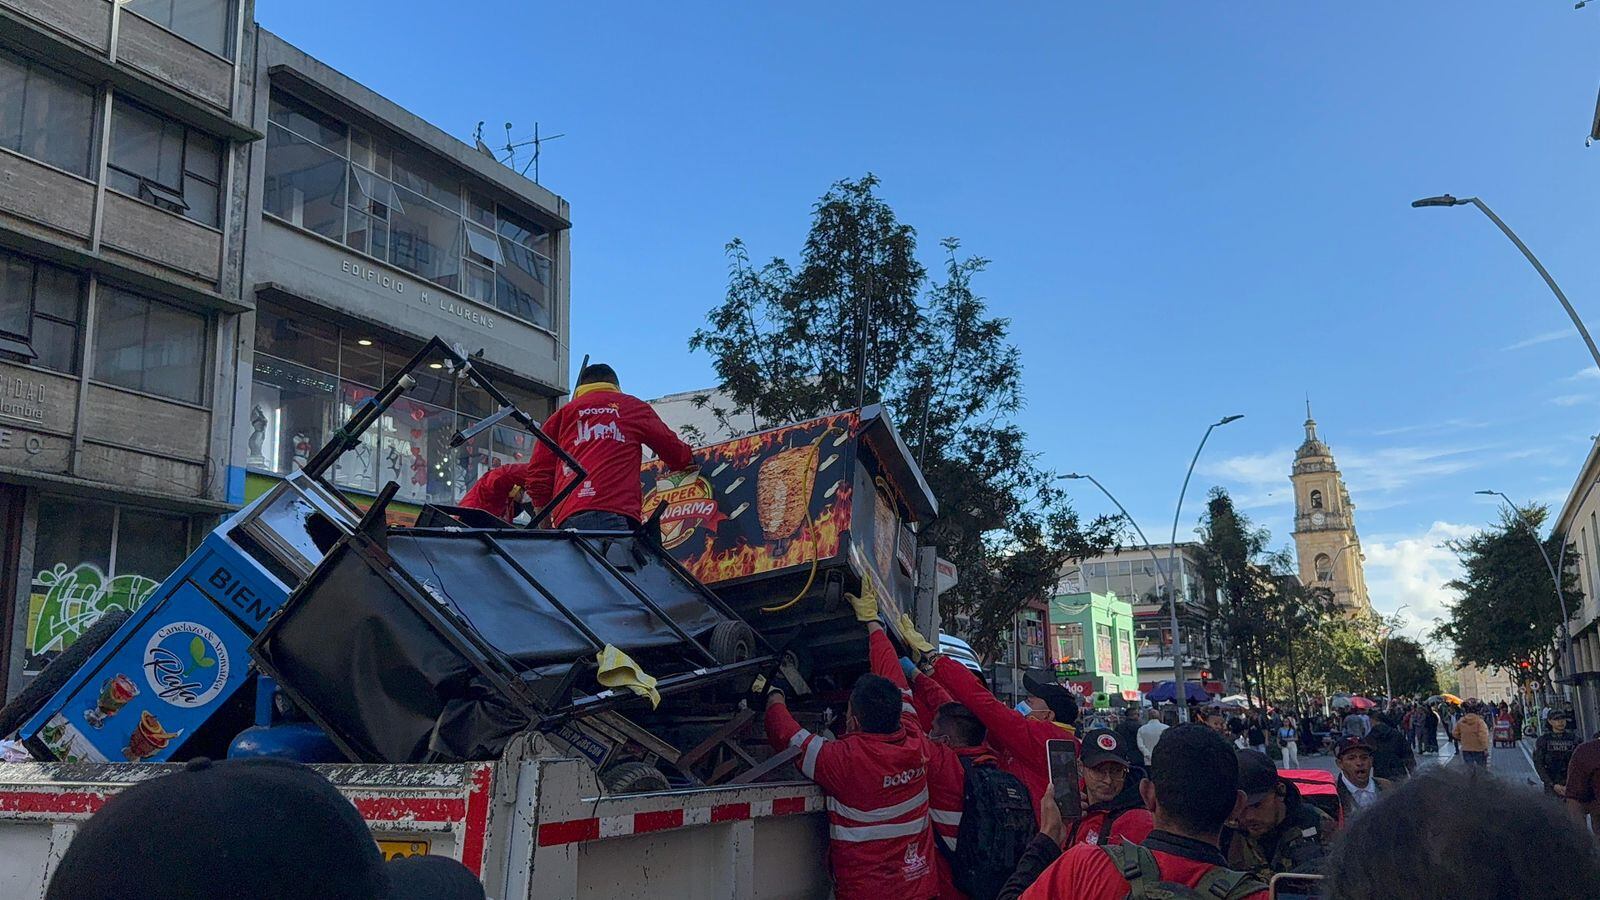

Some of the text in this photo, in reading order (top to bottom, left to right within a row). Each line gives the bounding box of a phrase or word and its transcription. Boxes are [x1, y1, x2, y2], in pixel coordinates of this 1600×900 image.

[341, 259, 404, 294] EDIFICIO
[439, 299, 495, 329] LAURENS
[0, 374, 45, 403] IDAD
[652, 486, 697, 508] SUPER
[660, 501, 715, 520] WARMA
[208, 566, 276, 622] BIEN
[158, 623, 204, 638] Canelazo
